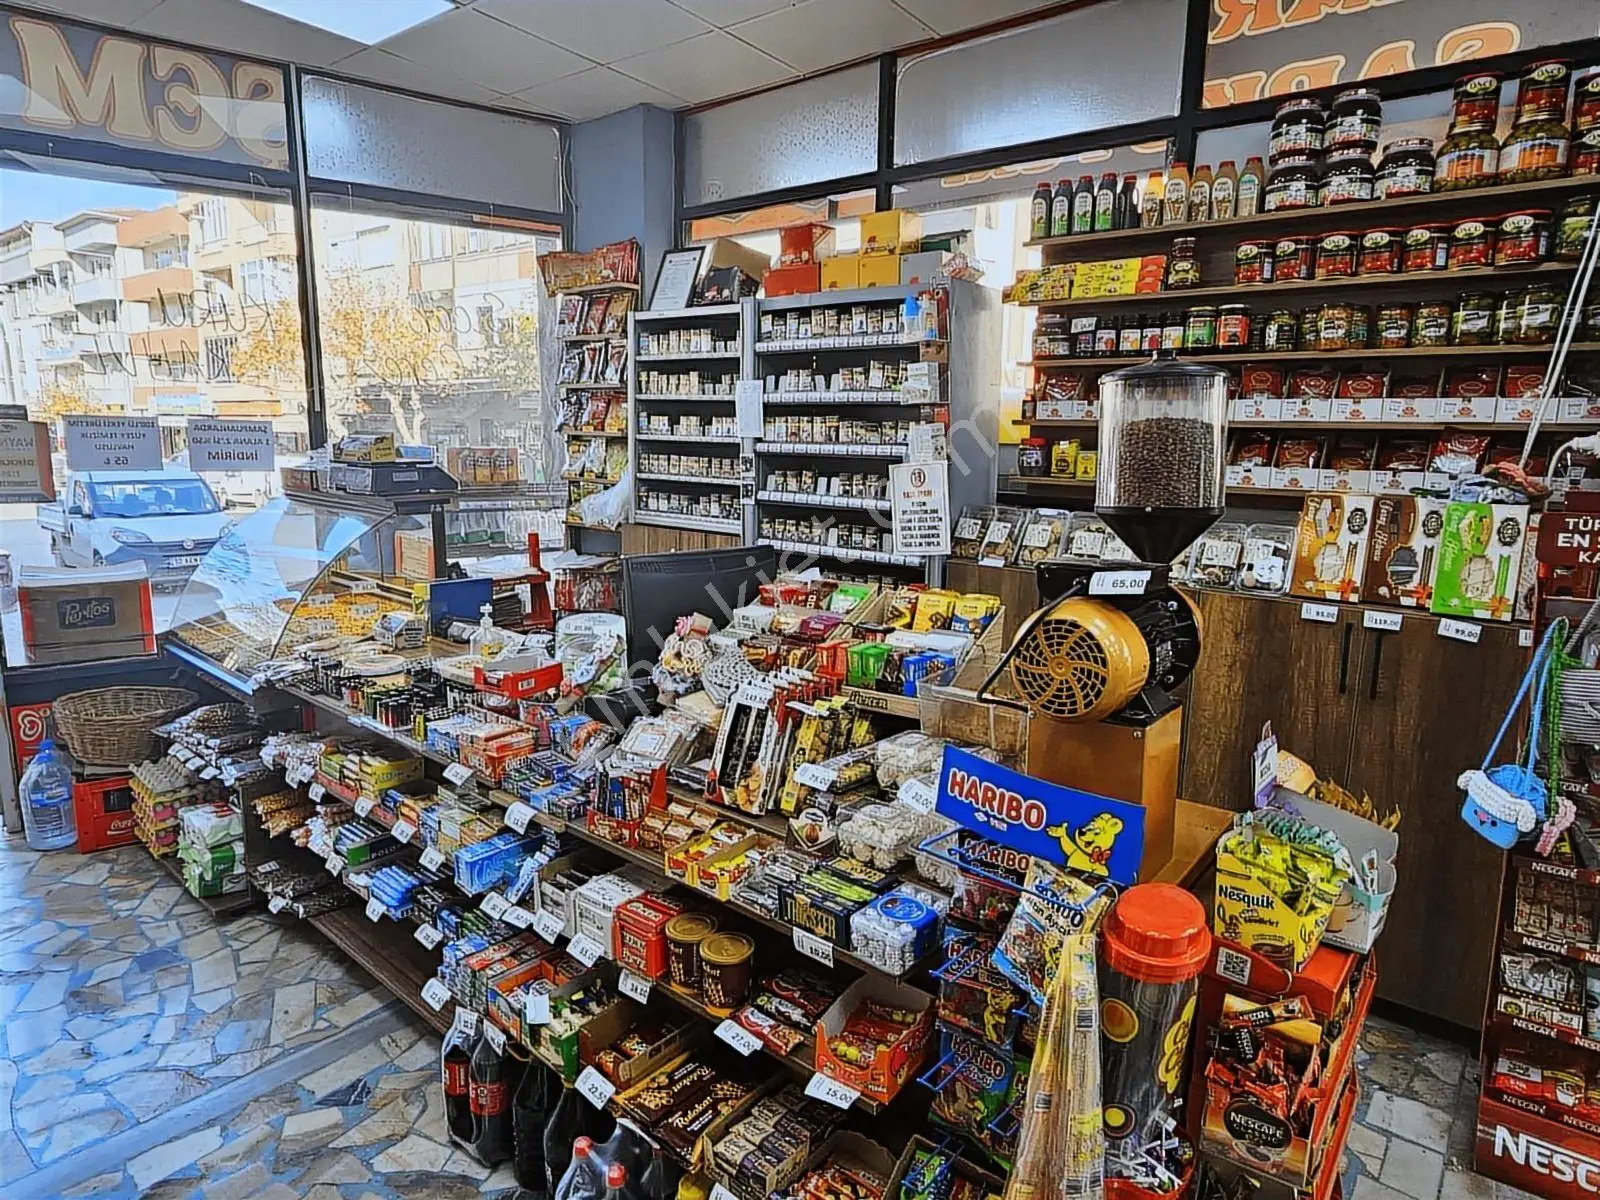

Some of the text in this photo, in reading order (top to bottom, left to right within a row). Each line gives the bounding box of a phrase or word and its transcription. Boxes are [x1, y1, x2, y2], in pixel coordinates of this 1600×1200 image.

[1557, 533, 1590, 548] EN
[948, 767, 1047, 831] HARIBO
[1531, 862, 1578, 880] NESCAFÉ
[1218, 884, 1275, 911] Nesquik
[1523, 936, 1568, 956] NESCAFÉ
[1513, 1018, 1558, 1038] NESCAFÉ
[952, 1033, 1006, 1080] HARIBO
[825, 1087, 853, 1104] 15.00
[1503, 1094, 1548, 1114] NESCAFÉ
[1229, 1110, 1285, 1140] NESCAFÉ
[1233, 1123, 1279, 1145] CLASSIC
